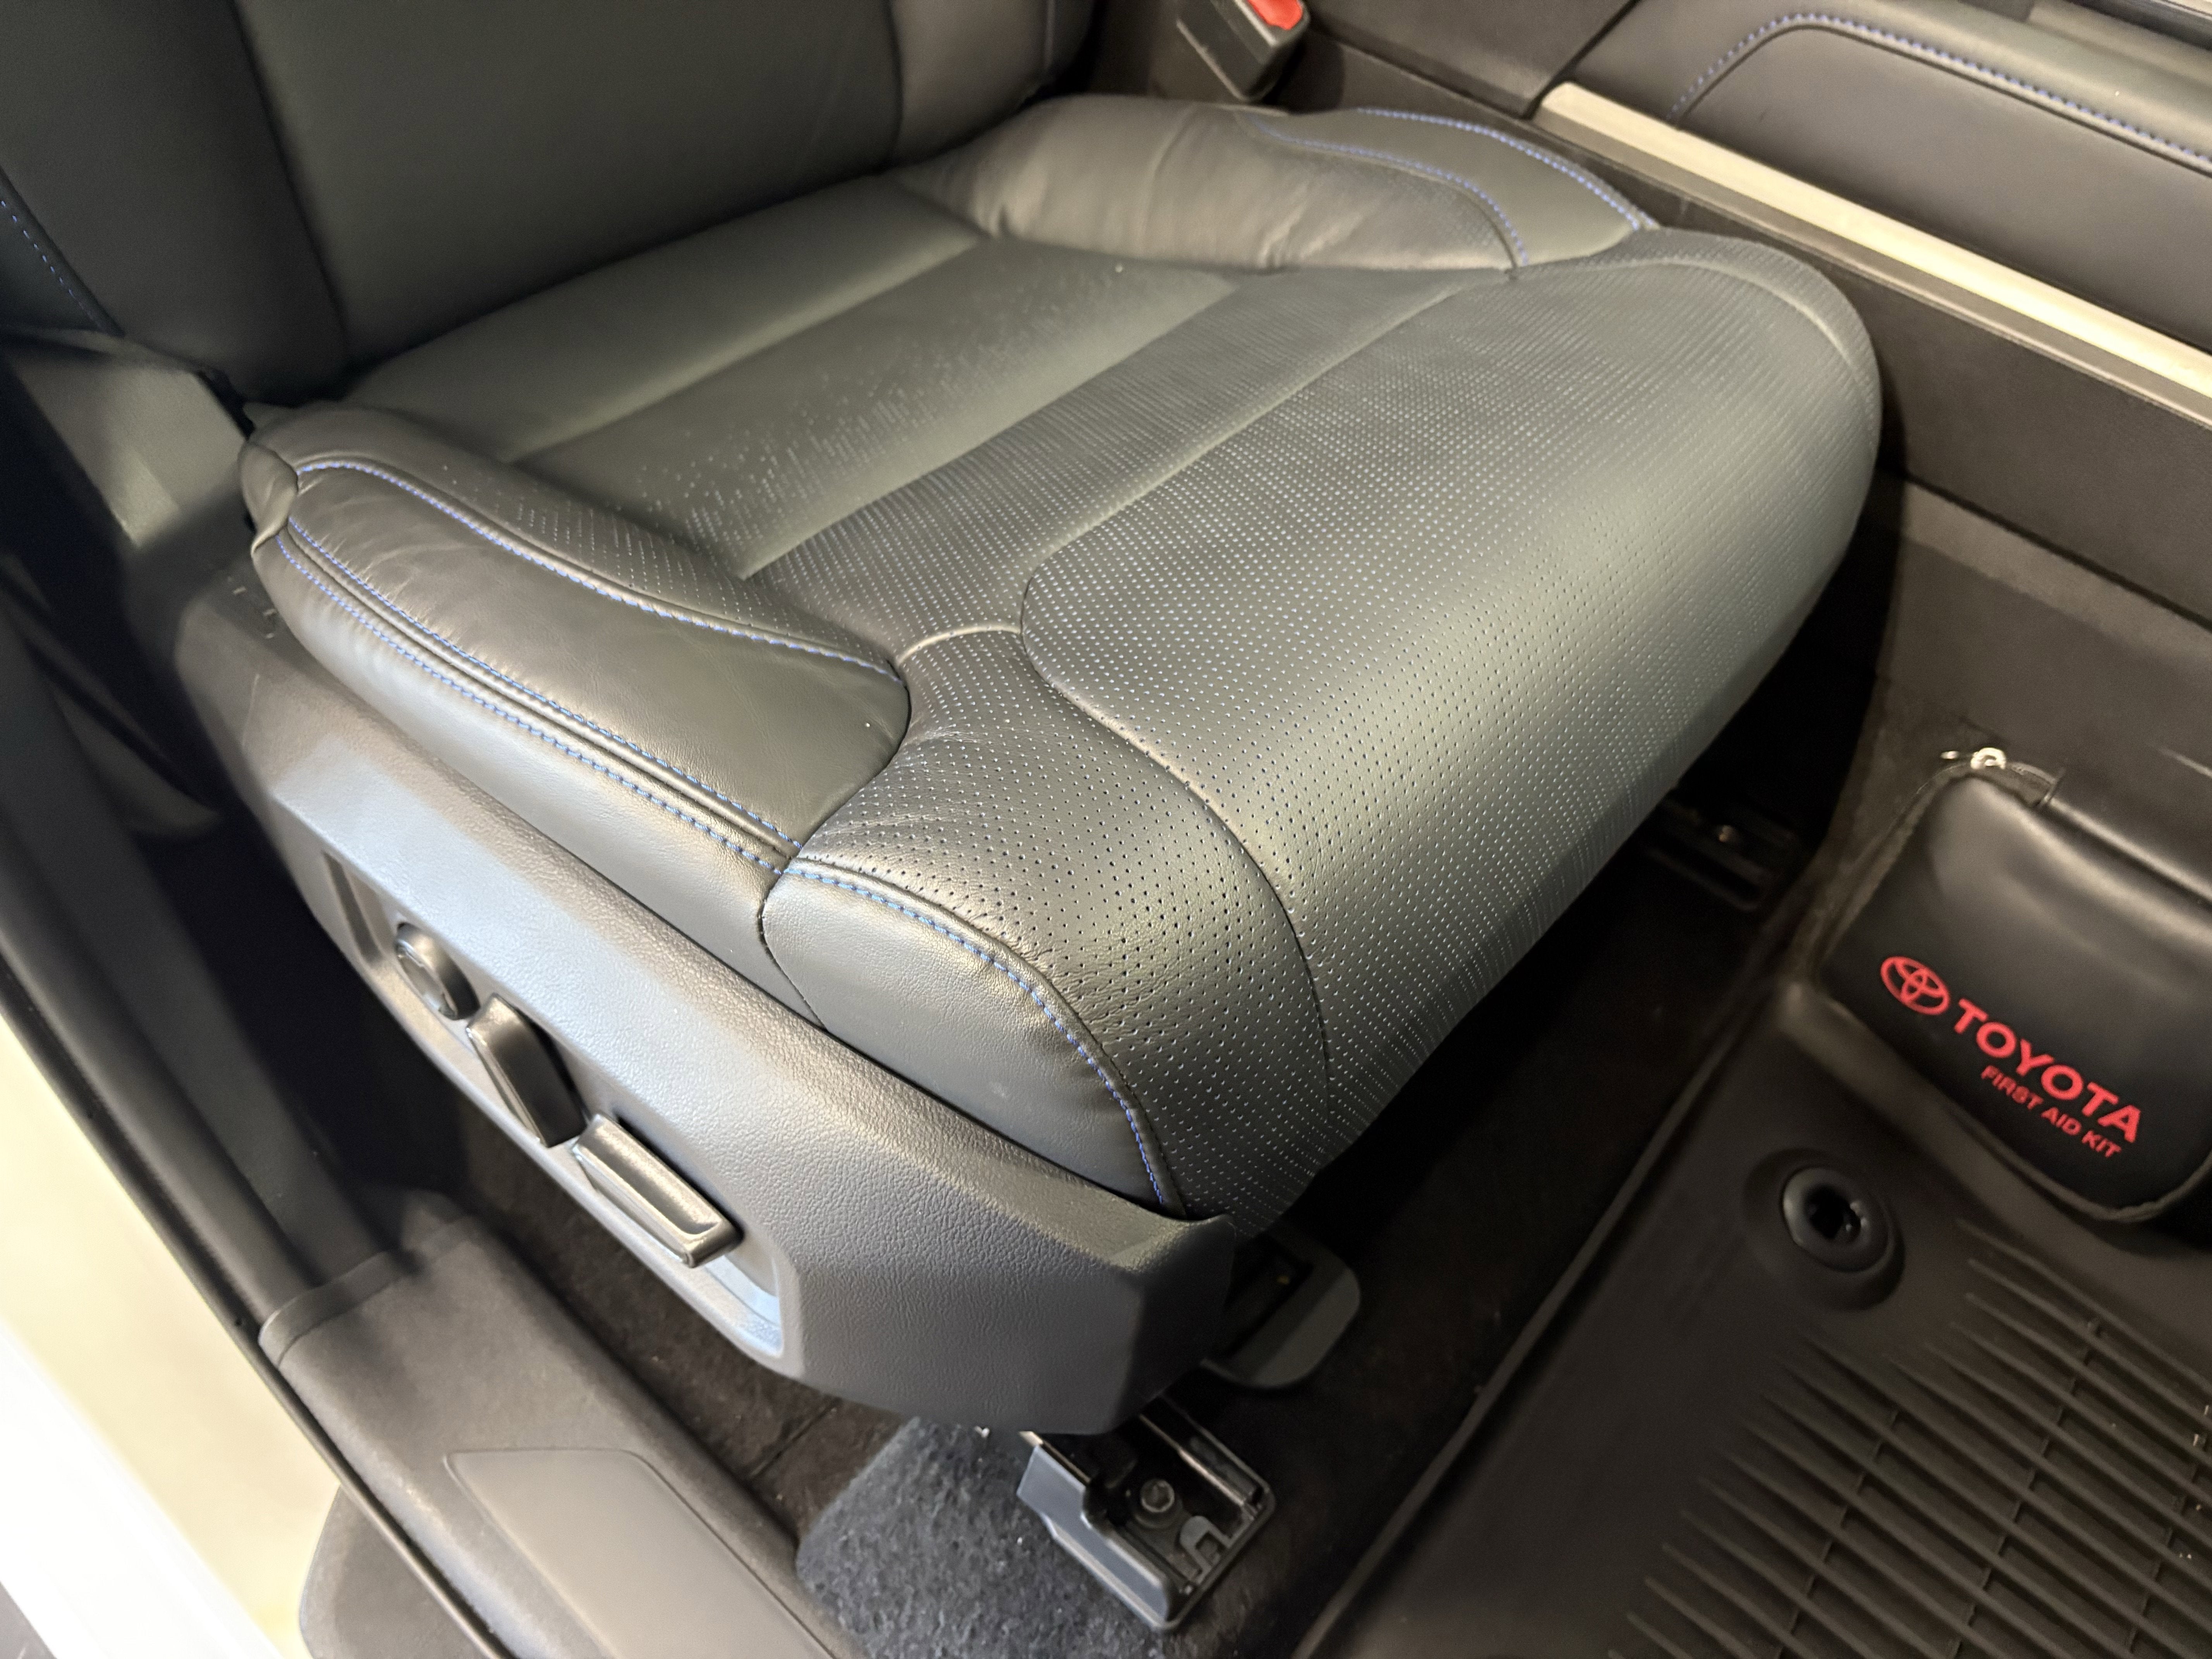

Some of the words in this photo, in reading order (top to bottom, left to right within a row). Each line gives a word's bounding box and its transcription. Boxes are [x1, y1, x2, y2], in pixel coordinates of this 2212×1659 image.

[1954, 998, 2141, 1143] TOYOTA
[1981, 1065, 2044, 1109] FIRST
[2041, 1107, 2081, 1135] AID
[2082, 1130, 2121, 1158] KIT
